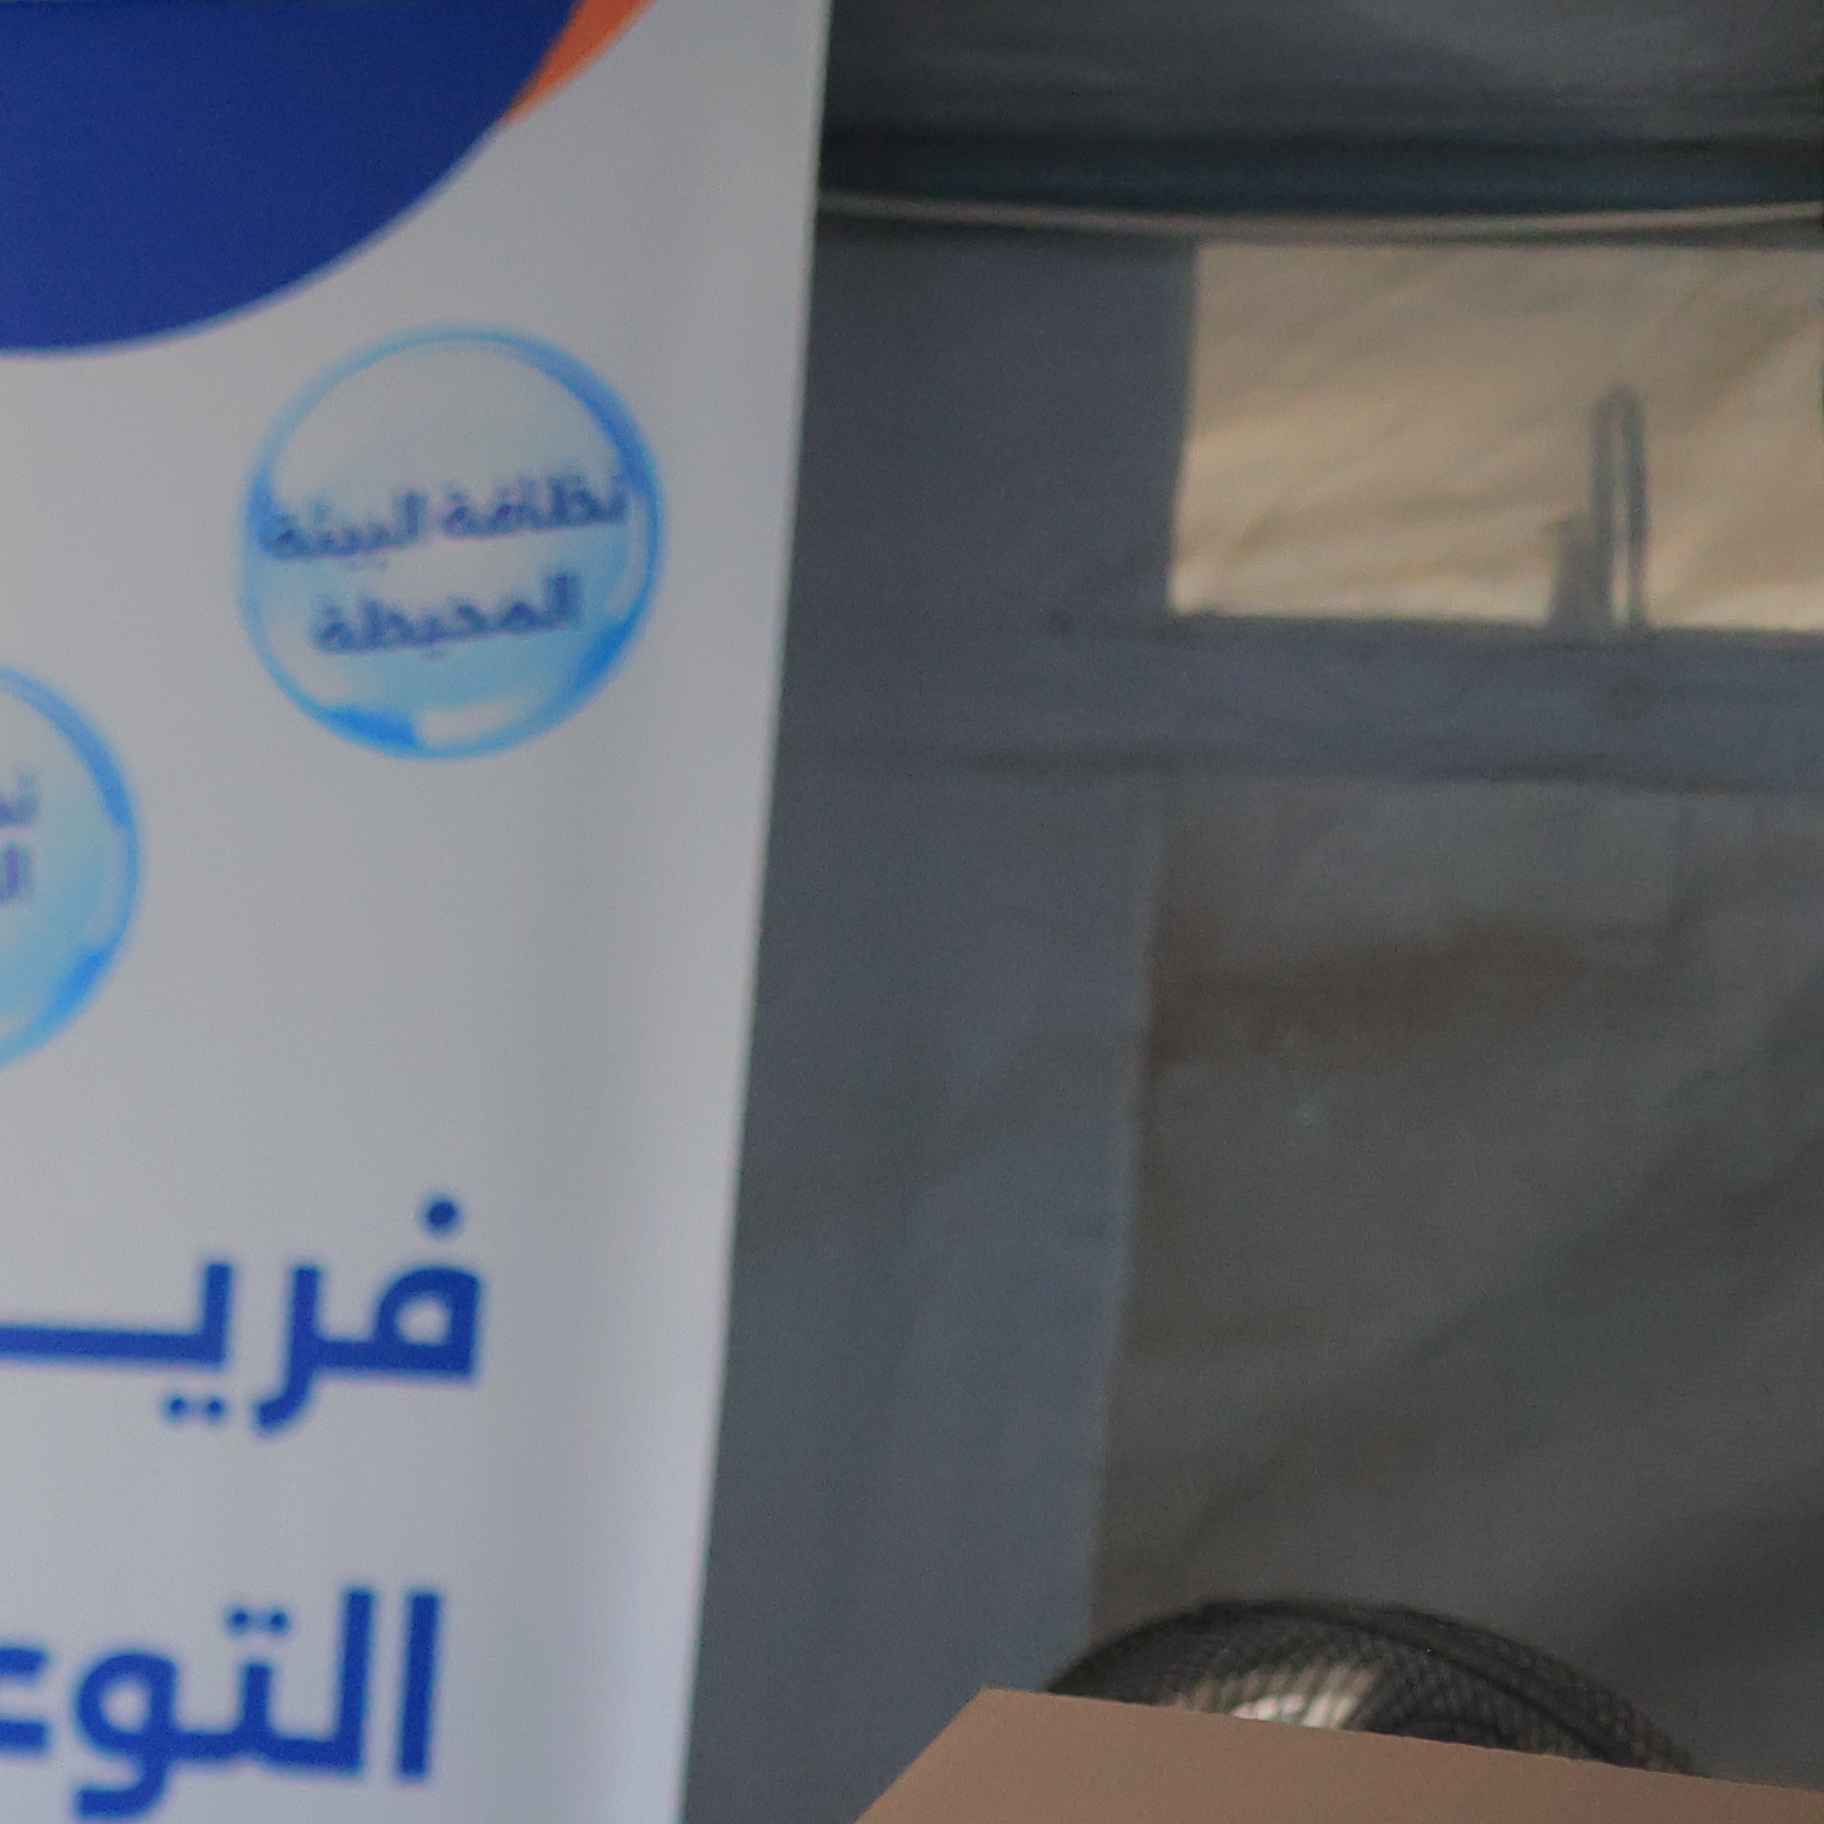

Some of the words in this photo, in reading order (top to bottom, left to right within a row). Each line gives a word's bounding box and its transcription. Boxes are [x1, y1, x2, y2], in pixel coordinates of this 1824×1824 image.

[258, 489, 427, 569] البيئة
[440, 473, 629, 542] نظافة
[313, 573, 582, 658] المحيطة
